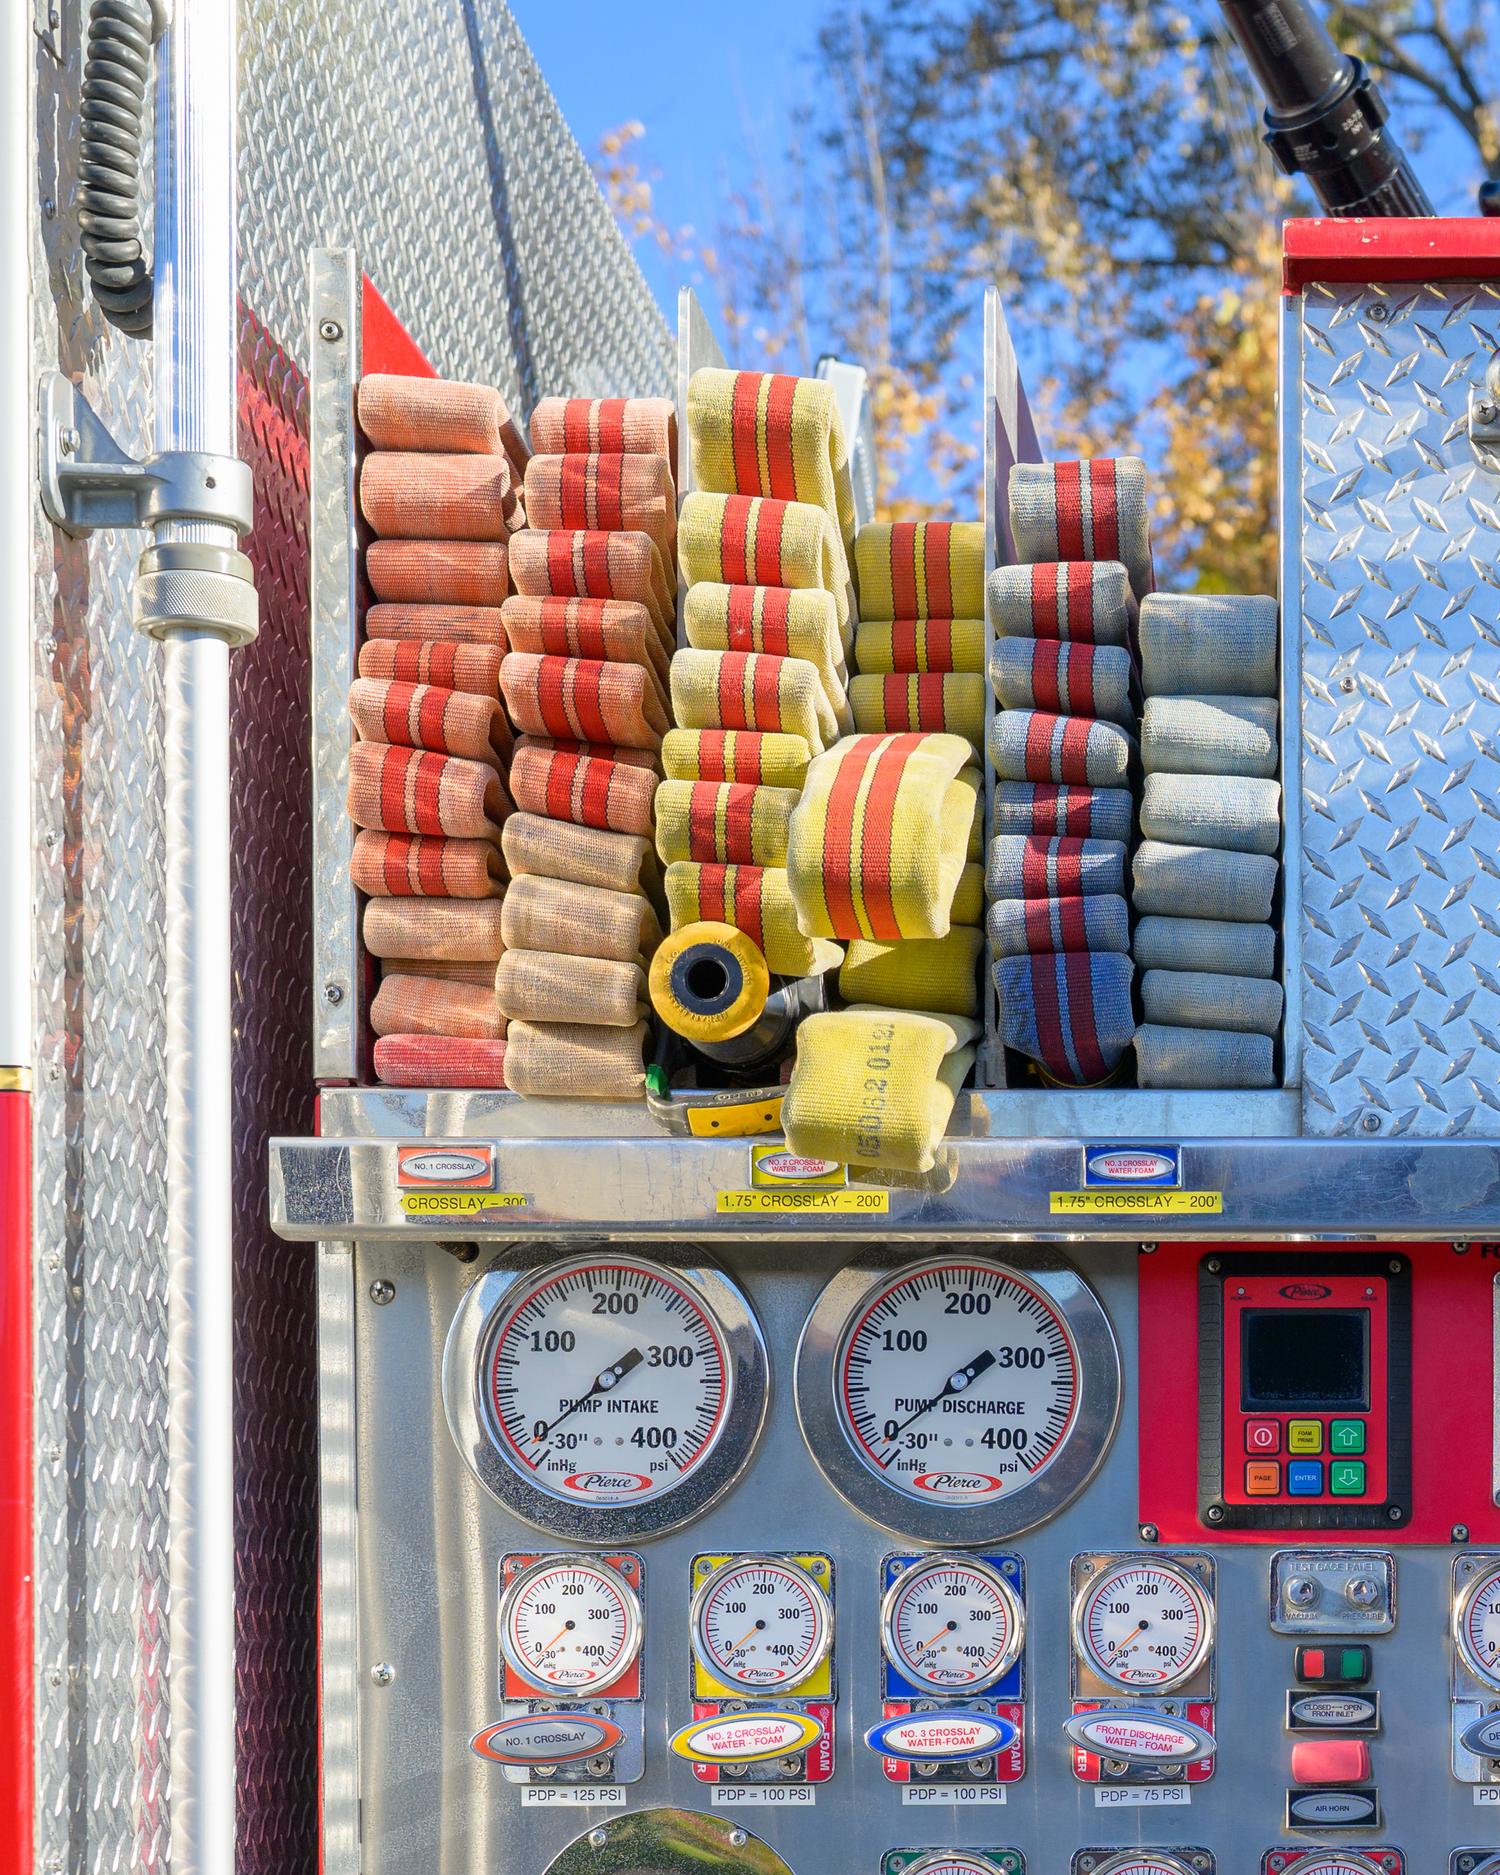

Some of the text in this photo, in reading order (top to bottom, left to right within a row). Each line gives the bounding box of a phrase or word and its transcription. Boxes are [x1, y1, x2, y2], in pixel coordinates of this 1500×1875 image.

[414, 1162, 430, 1171] NO.
[439, 1162, 476, 1171] CROSSLAY
[768, 1158, 782, 1167] NO.
[789, 1158, 827, 1168] CROSSLAY
[771, 1165, 795, 1174] WATER
[802, 1165, 825, 1173] FOAM
[1104, 1159, 1117, 1167] NO.
[1124, 1159, 1159, 1168] CROSSLAY
[1107, 1166, 1155, 1175] WATER-FOAM
[406, 1195, 487, 1210] CROSSLAY
[723, 1193, 759, 1207] 1.75"
[760, 1193, 839, 1208] CROSSLAY
[855, 1193, 884, 1208] 200'
[1057, 1193, 1091, 1207] 1.75"
[1094, 1193, 1173, 1208] CROSSLAY
[1189, 1193, 1218, 1208] 200'
[591, 1293, 639, 1315] 200
[944, 1292, 991, 1315] 200
[529, 1330, 576, 1352] 100
[881, 1329, 928, 1353] 100
[646, 1345, 694, 1368] 300
[998, 1346, 1046, 1369] 300
[559, 1399, 659, 1414] PUMP INTAKE
[894, 1398, 1026, 1416] PUMP DISCHARGE
[533, 1420, 549, 1442] 0
[629, 1426, 678, 1449] 400
[980, 1427, 1028, 1450] 400
[547, 1458, 577, 1474] inHg
[649, 1458, 669, 1474] psi
[583, 1473, 632, 1490] Pierce
[933, 1473, 982, 1491] Pierce
[1253, 1474, 1273, 1482] PAGE
[1294, 1474, 1317, 1482] ENTER
[561, 1584, 584, 1596] 200
[534, 1603, 556, 1615] 100
[587, 1608, 610, 1620] 300
[582, 1645, 605, 1657] 400
[505, 1736, 524, 1747] NO.
[533, 1730, 586, 1744] CROSSLAY
[1095, 1724, 1184, 1745] FRONT DISCHARGE
[528, 1789, 557, 1801] PDP
[572, 1789, 596, 1801] 125
[598, 1789, 621, 1800] PSI
[1100, 1790, 1129, 1802] PDP
[1143, 1789, 1160, 1801] 75
[1162, 1789, 1183, 1800] PSI
